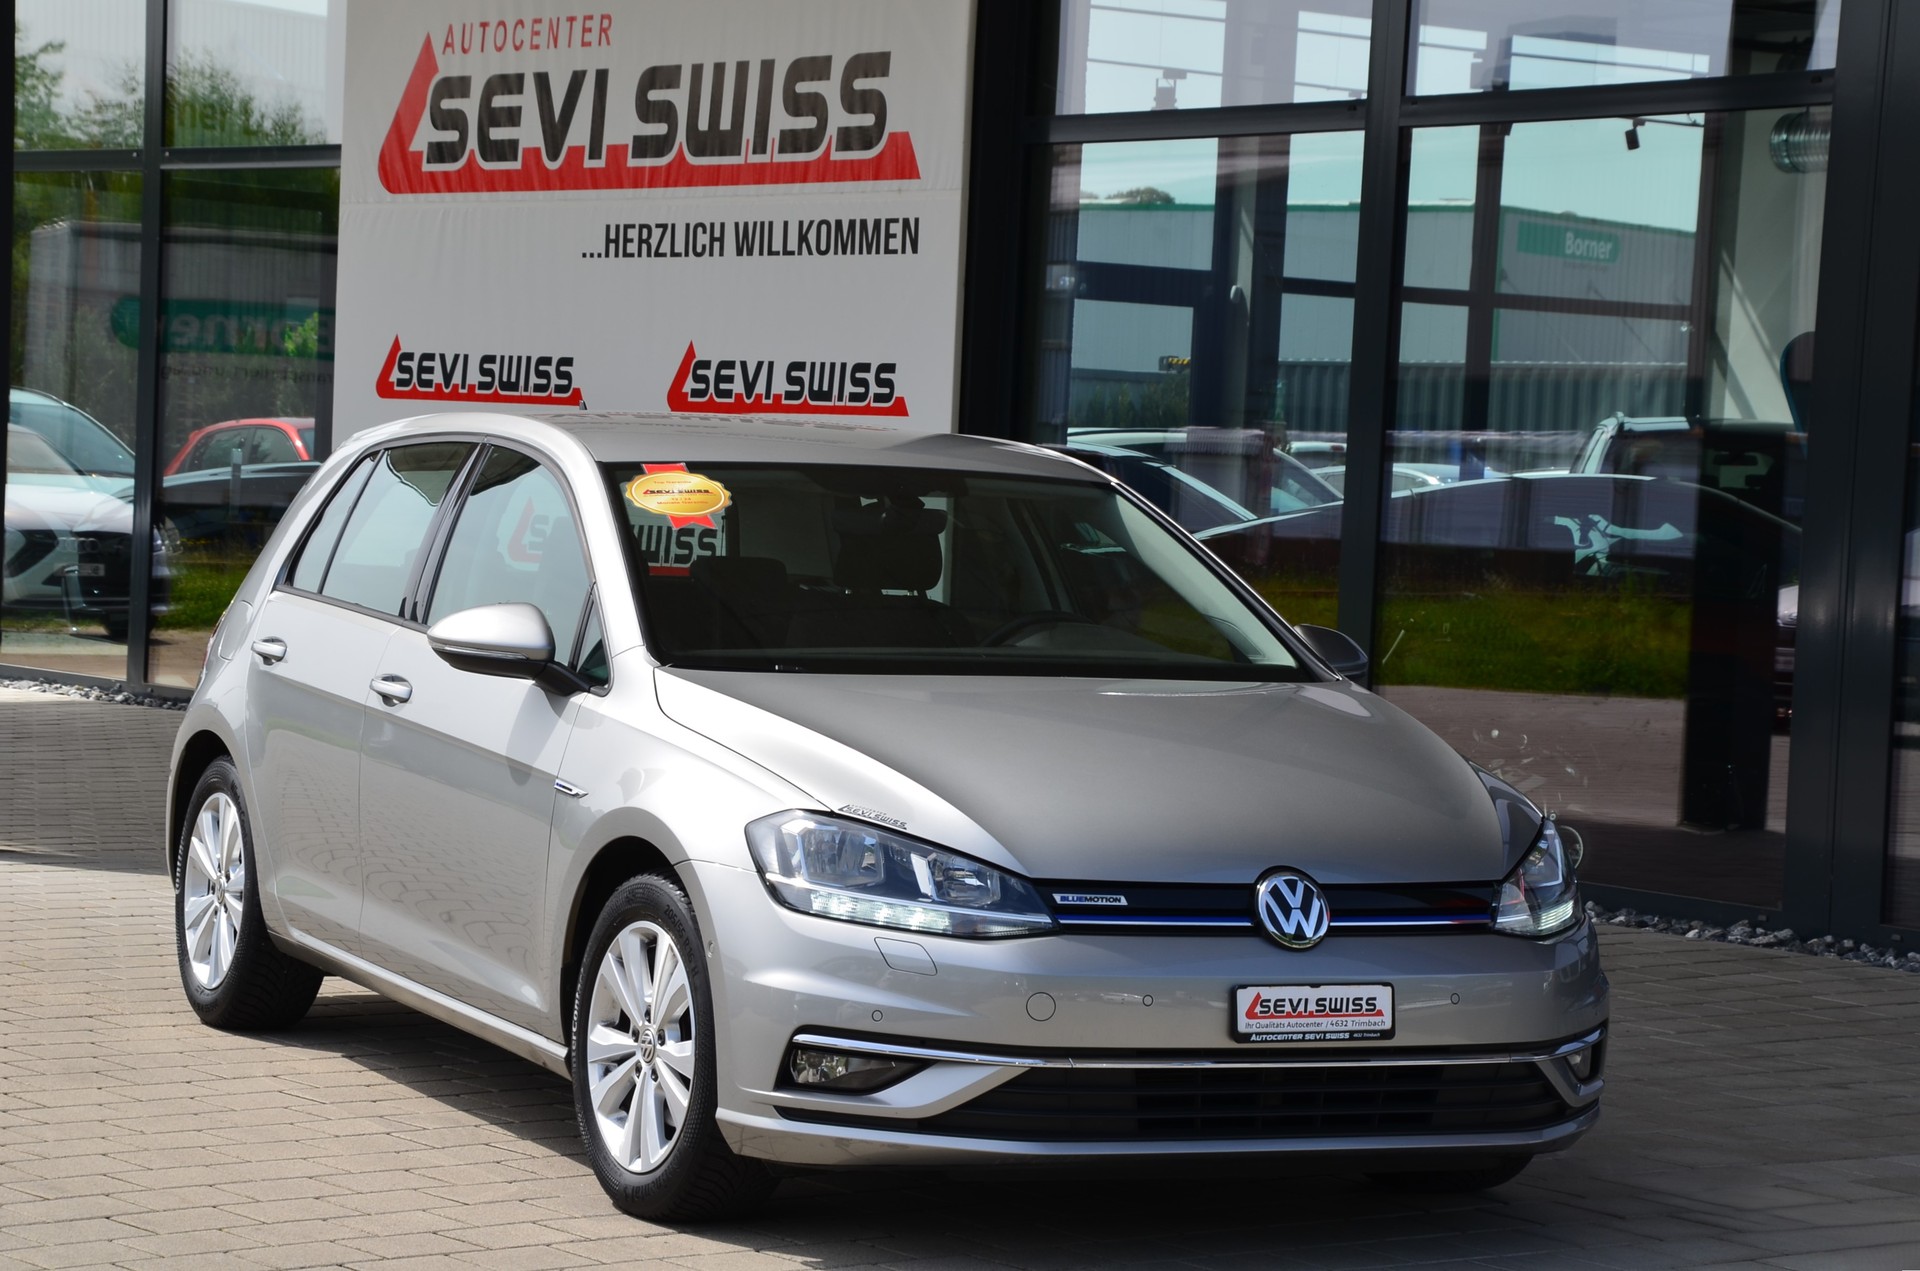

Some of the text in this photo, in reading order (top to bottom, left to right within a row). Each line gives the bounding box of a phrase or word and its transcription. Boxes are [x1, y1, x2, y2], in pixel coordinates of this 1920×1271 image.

[442, 13, 613, 56] AUTOCENTER
[426, 51, 892, 164] SEVI SWISS
[734, 217, 920, 257] WILLKOMMEN
[1564, 231, 1613, 259] Borner
[395, 351, 575, 395] SEVI SWISS
[689, 359, 897, 404] SEVI SWISS
[632, 524, 719, 563] WISS
[1060, 895, 1122, 904] BLUEMOTION
[1259, 996, 1377, 1015] SEVI SWISS
[1286, 1020, 1323, 1029] Autocenter
[1329, 1019, 1349, 1028] 4632
[1351, 1019, 1386, 1027] Trimbach
[1304, 1032, 1324, 1040] SEVI
[1325, 1032, 1350, 1040] SWISS
